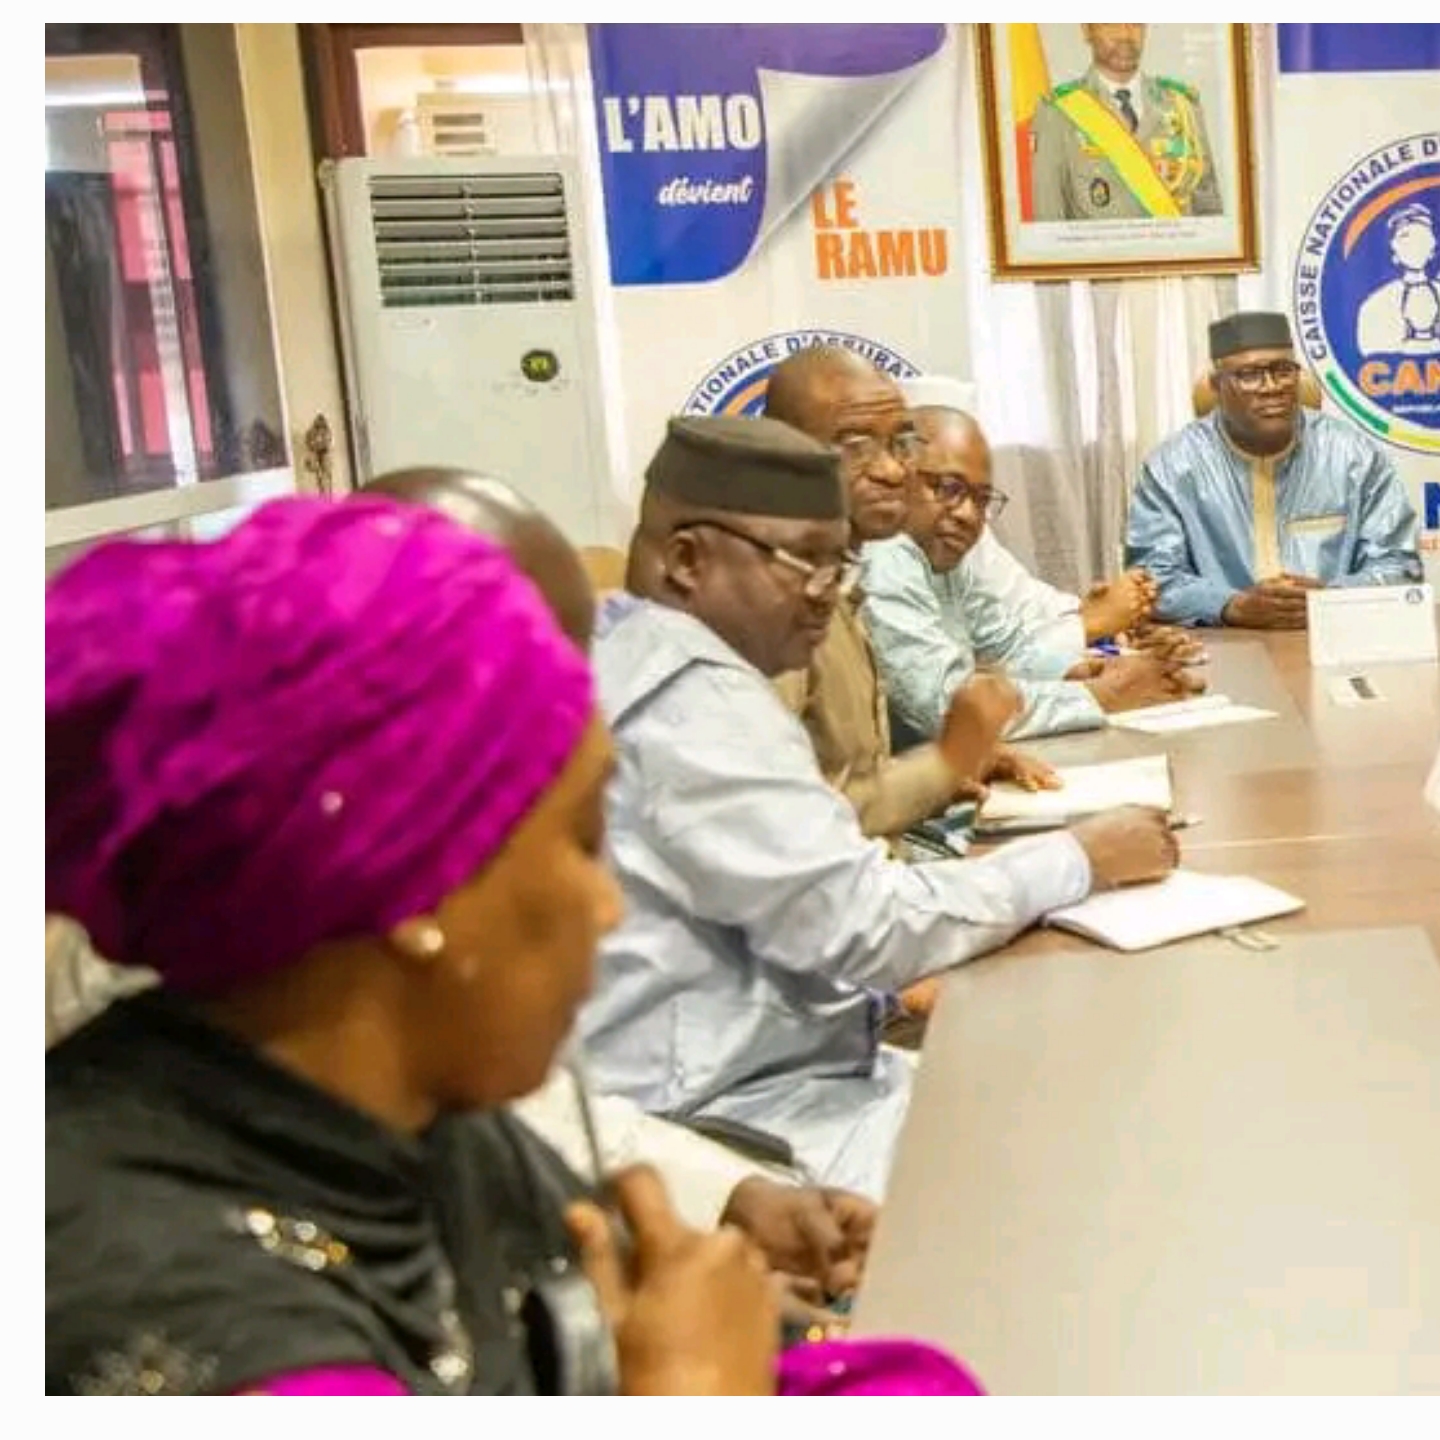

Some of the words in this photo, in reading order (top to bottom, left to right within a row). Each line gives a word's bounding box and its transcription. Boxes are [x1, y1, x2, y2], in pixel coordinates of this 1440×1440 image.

[603, 94, 762, 153] L'AMO
[811, 181, 859, 229] LE
[1305, 143, 1415, 257] NATIONALE
[814, 229, 949, 280] RAMU
[1300, 265, 1328, 361] CAISSE
[691, 342, 780, 413] TIONALE
